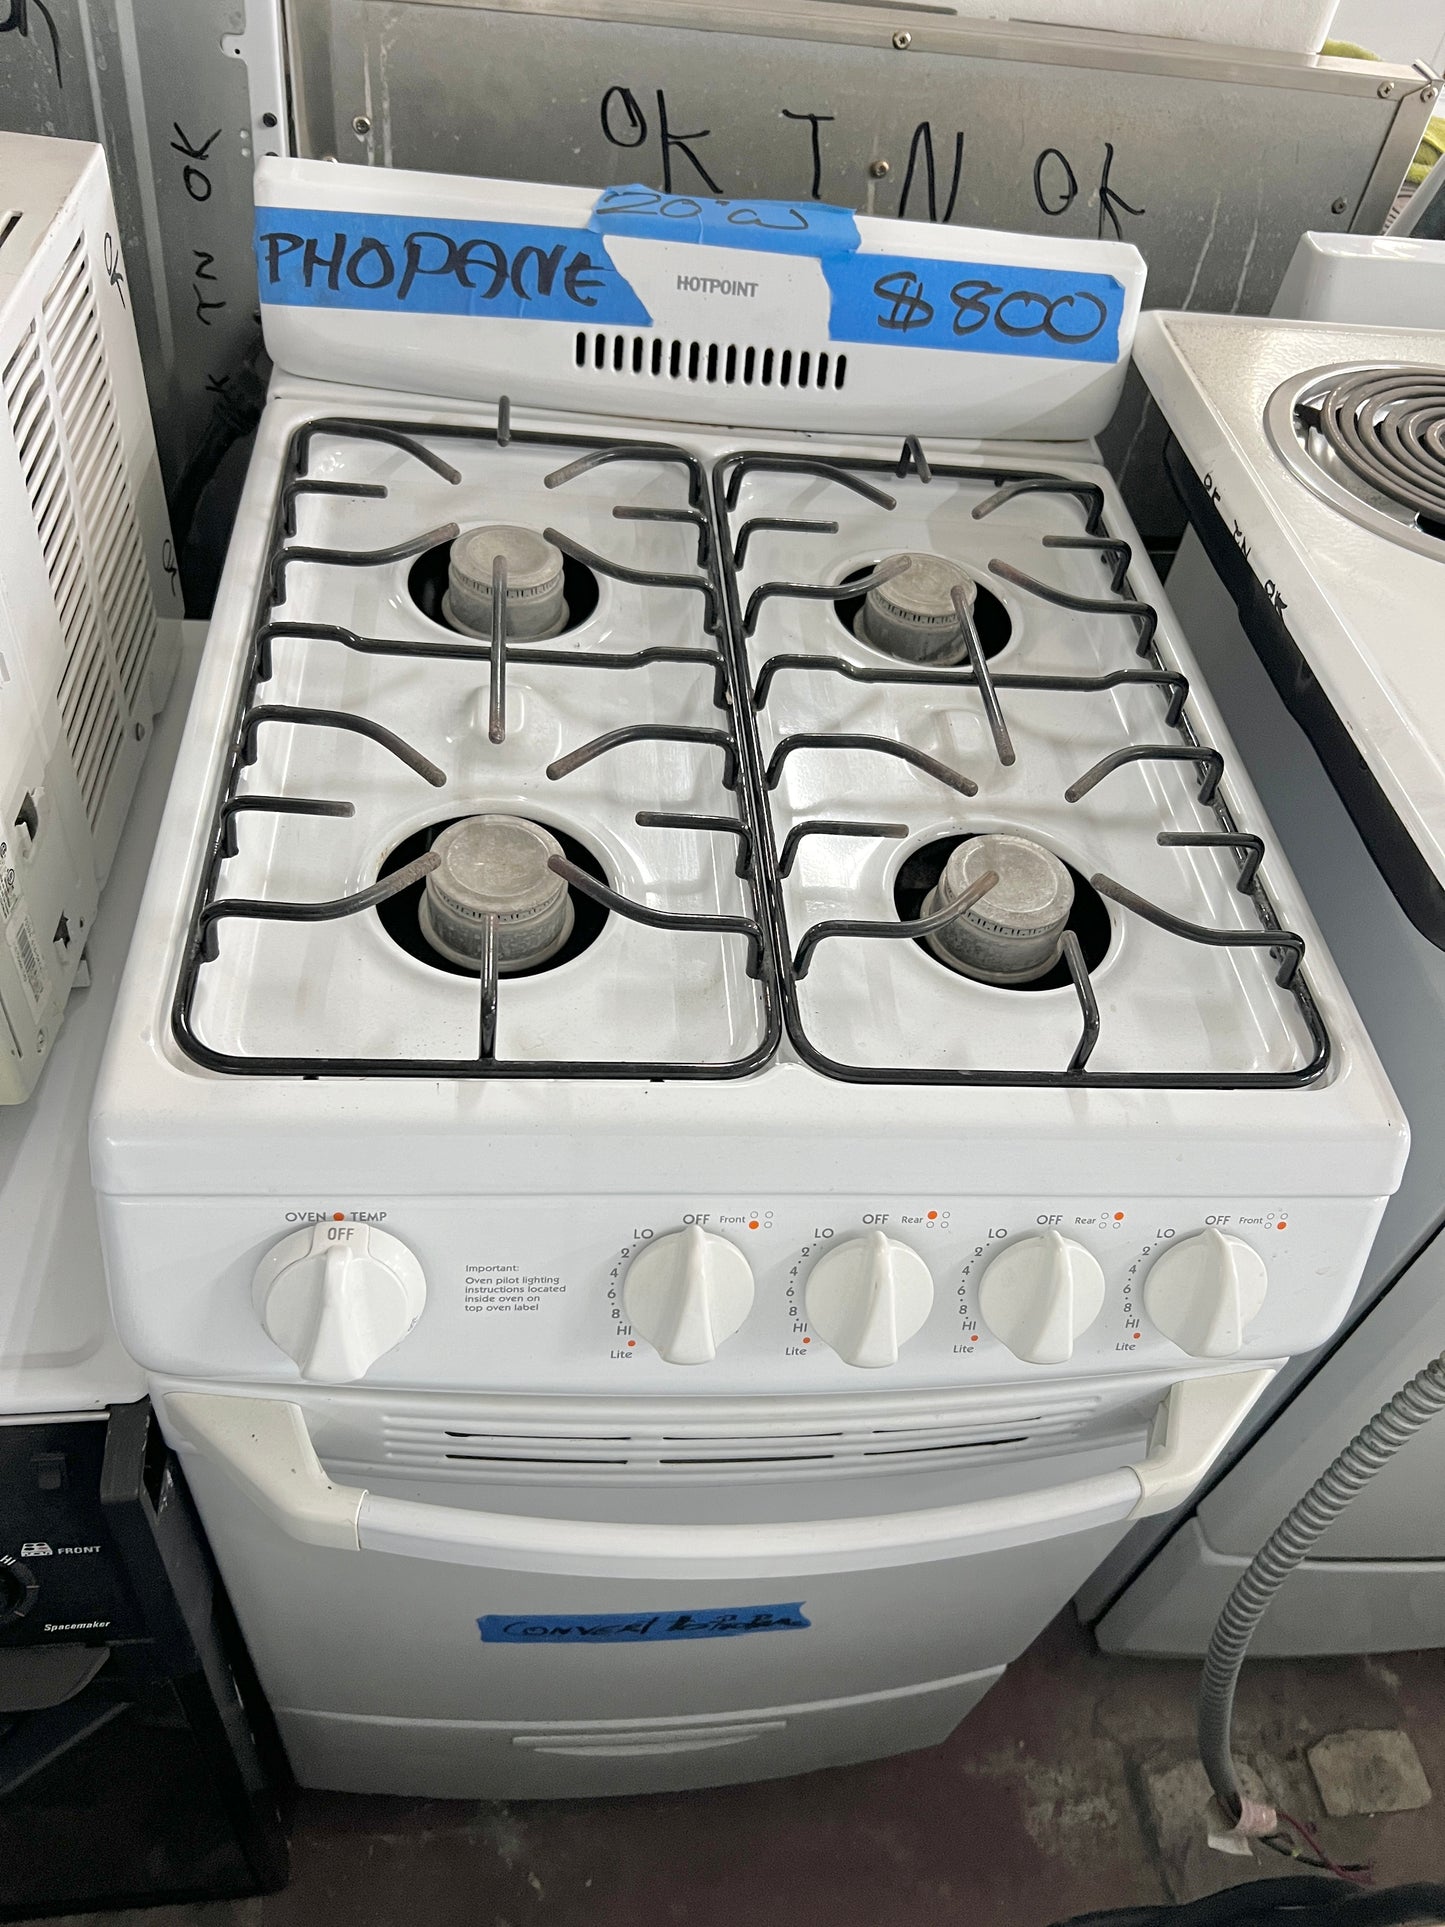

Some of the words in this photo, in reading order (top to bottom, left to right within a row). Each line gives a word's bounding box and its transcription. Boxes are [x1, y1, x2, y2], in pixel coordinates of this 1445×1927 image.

[170, 121, 223, 201] OK
[601, 86, 723, 194] OK
[1034, 143, 1145, 240] OK
[676, 275, 759, 298] HOTPOINT
[284, 1212, 327, 1222] OVEN
[350, 1211, 387, 1222] TEMP
[682, 1213, 711, 1225] OFF
[719, 1215, 746, 1224] Front
[862, 1213, 890, 1225] OFF
[901, 1215, 924, 1224] Rear
[1036, 1214, 1064, 1225] OFF
[1074, 1216, 1097, 1225] Rear
[1204, 1215, 1232, 1226] OFF
[1238, 1216, 1263, 1225] Front
[327, 1227, 355, 1241] OFF
[633, 1228, 654, 1240] LO
[814, 1228, 834, 1239] LO
[988, 1228, 1008, 1239] LO
[1156, 1228, 1176, 1239] LO
[621, 1248, 630, 1258] 2
[801, 1247, 810, 1257] 2
[974, 1246, 983, 1257] 2
[1142, 1246, 1151, 1256] 2
[465, 1264, 520, 1273] Important:
[610, 1268, 619, 1278] 4
[789, 1266, 798, 1276] 4
[961, 1265, 970, 1276] 4
[1128, 1264, 1137, 1275] 4
[465, 1276, 493, 1285] Oven
[495, 1276, 520, 1286] pilot
[522, 1276, 560, 1286] lighting
[465, 1285, 525, 1294] instructions
[527, 1284, 567, 1293] located
[607, 1288, 616, 1299] 6
[786, 1286, 795, 1297] 6
[957, 1285, 966, 1296] 6
[1122, 1284, 1132, 1294] 6
[464, 1294, 496, 1303] inside
[464, 1304, 483, 1313] top
[485, 1304, 511, 1312] oven
[514, 1303, 539, 1312] label
[788, 1306, 798, 1316] 8
[958, 1304, 968, 1315] 8
[1123, 1302, 1132, 1312] 8
[611, 1308, 620, 1319] 8
[792, 1322, 808, 1333] HI
[961, 1320, 977, 1331] HI
[1125, 1318, 1140, 1329] HI
[616, 1325, 632, 1336] HI
[785, 1347, 807, 1356] Lite
[953, 1344, 975, 1353] Lite
[1115, 1342, 1136, 1351] Lite
[610, 1350, 633, 1359] Lite
[57, 1545, 101, 1555] FRONT
[44, 1621, 111, 1632] Spacemaker
